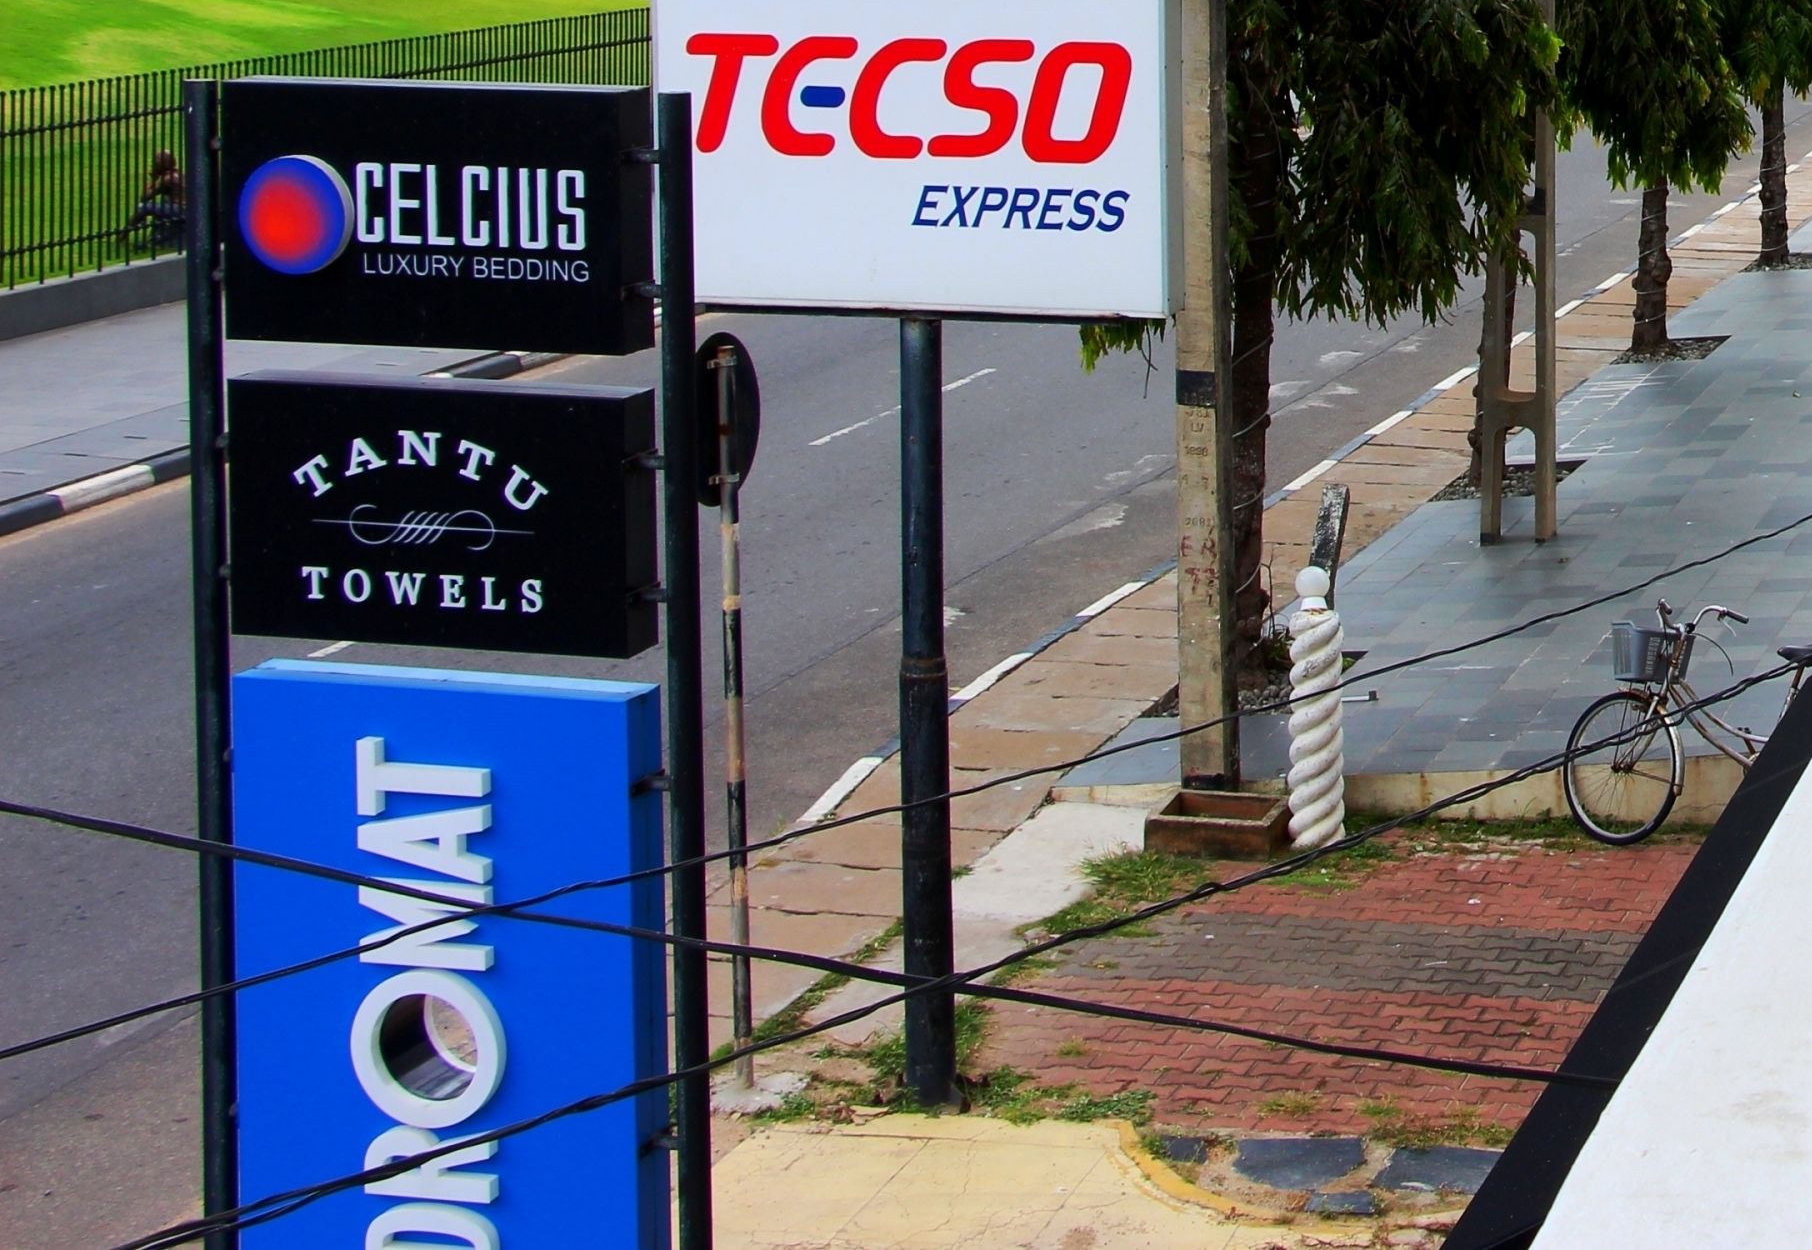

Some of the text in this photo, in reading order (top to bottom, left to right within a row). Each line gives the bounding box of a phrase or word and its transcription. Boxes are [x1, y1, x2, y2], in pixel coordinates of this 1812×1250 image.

[686, 33, 1132, 165] TECSO
[356, 162, 586, 251] CELCIUS
[911, 185, 1130, 232] EXPRESS
[363, 253, 589, 283] LUXURY BEDDING
[292, 429, 549, 512] TANTU
[301, 565, 543, 614] TOWELS
